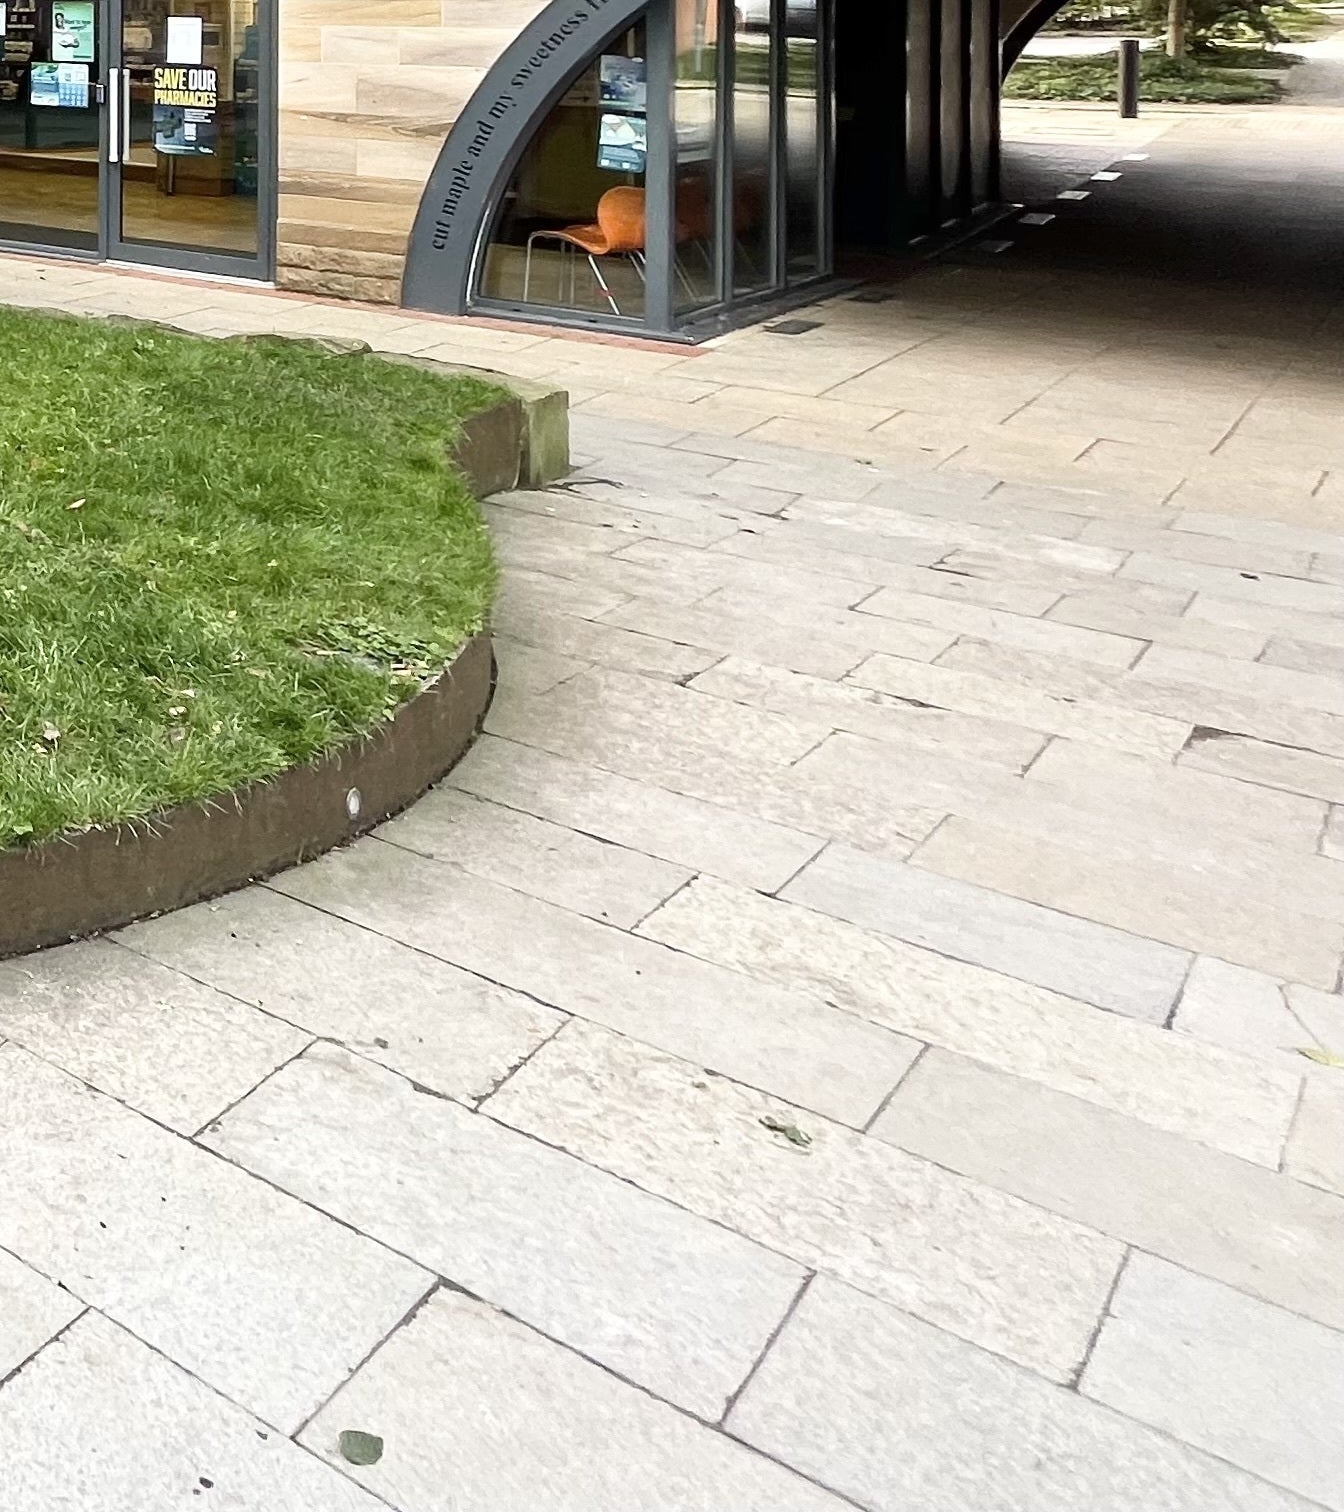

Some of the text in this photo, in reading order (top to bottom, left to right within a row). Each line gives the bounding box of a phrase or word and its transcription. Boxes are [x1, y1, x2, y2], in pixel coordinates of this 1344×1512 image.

[154, 67, 217, 92] SAVE OUR
[154, 89, 217, 108] PHARMACIES
[431, 220, 451, 251] cut
[441, 160, 474, 217] maple
[467, 120, 496, 158] and
[488, 90, 518, 119] my
[510, 9, 590, 89] sweetness
